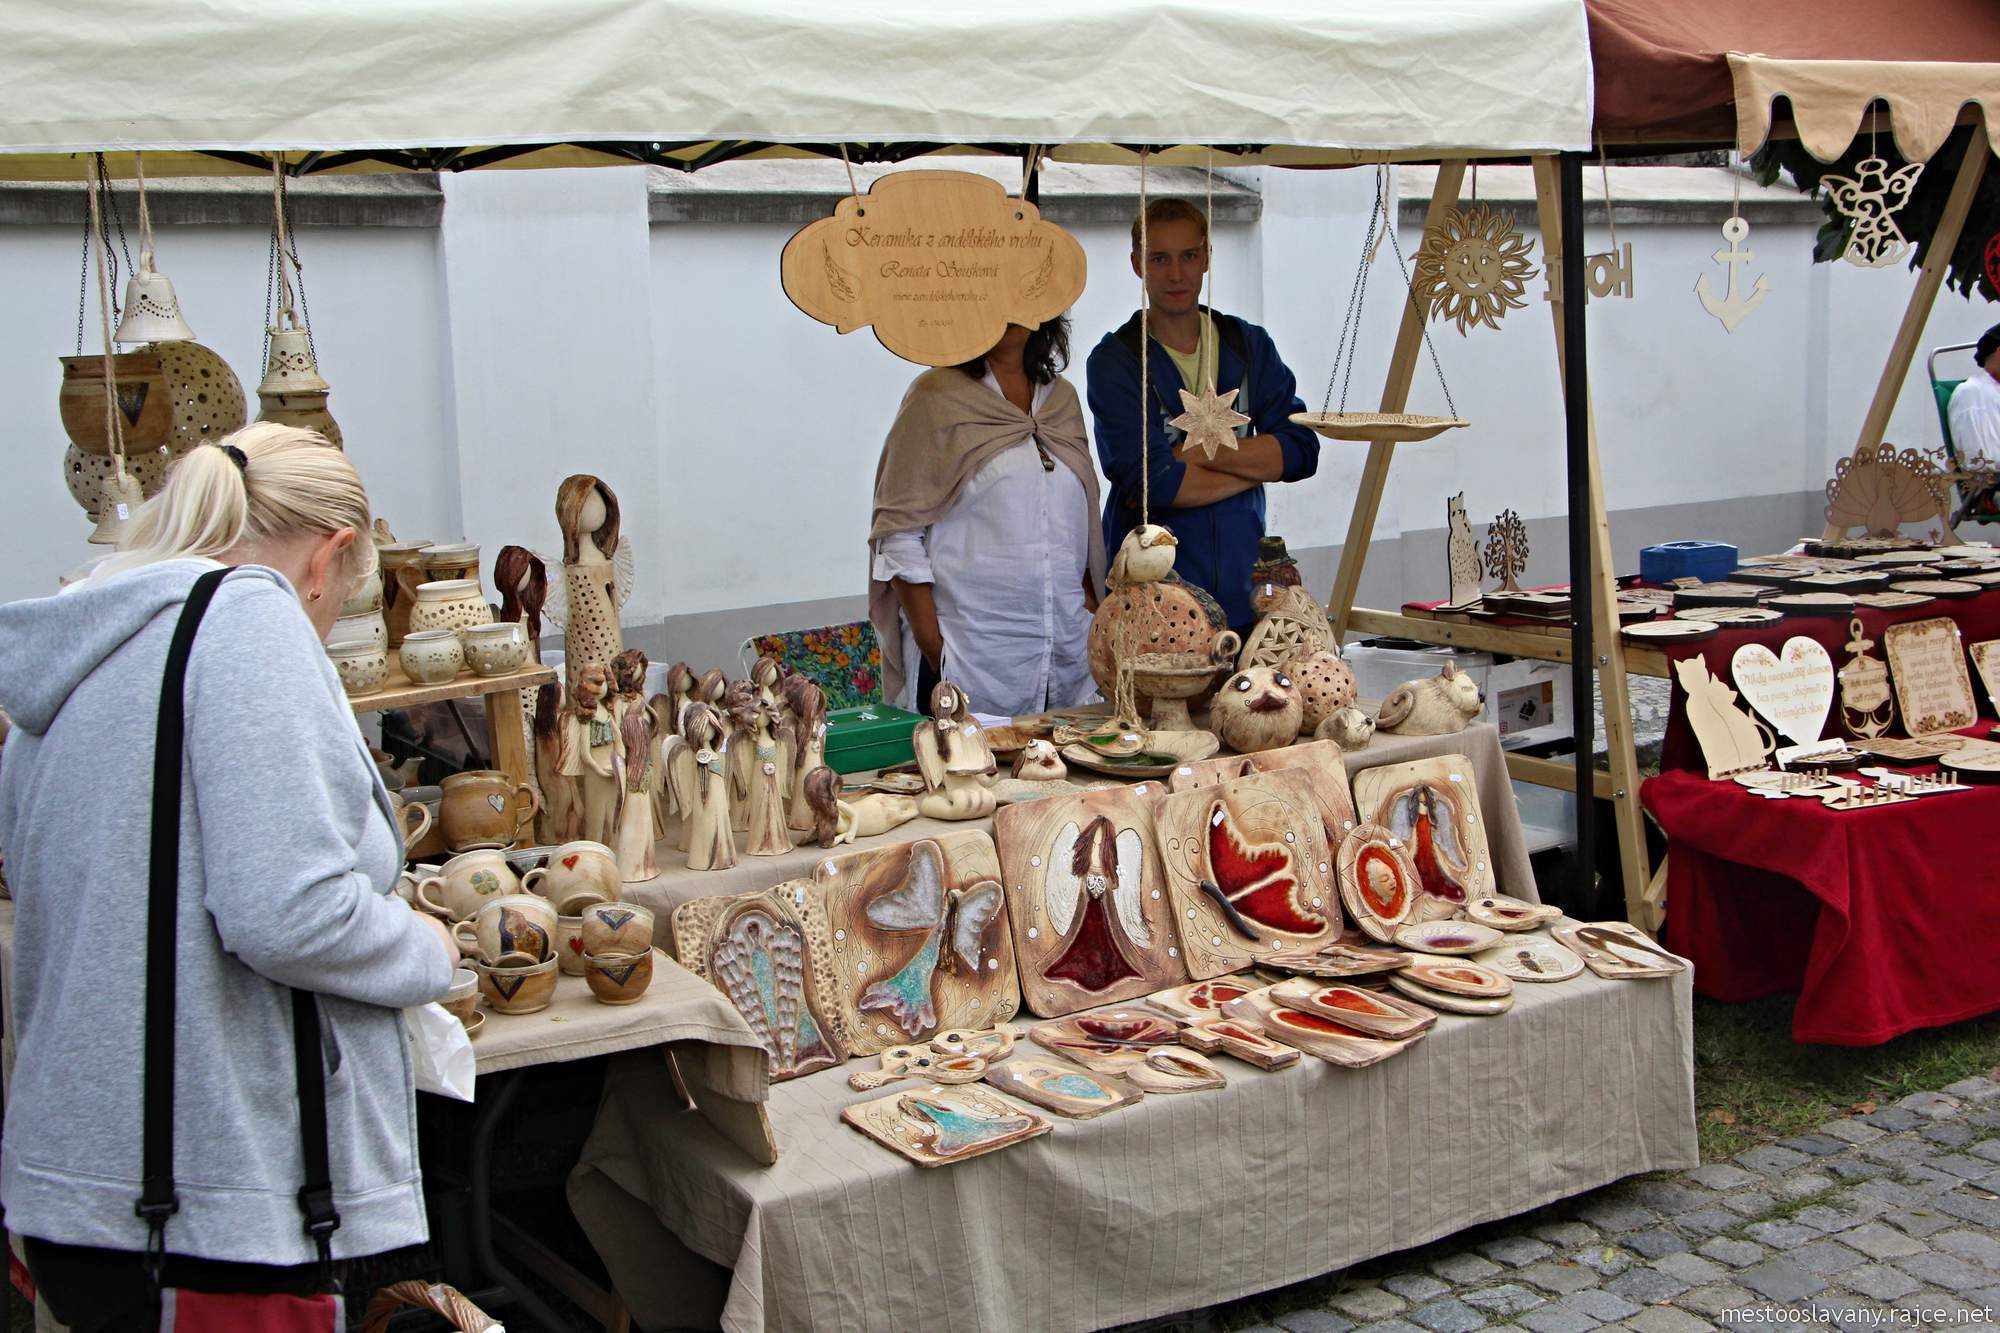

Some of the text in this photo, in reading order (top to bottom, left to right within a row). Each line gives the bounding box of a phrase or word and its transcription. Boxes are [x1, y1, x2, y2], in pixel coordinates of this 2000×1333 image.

[845, 226, 1043, 248] Keramika z andělského vrchu
[880, 260, 932, 279] Renata
